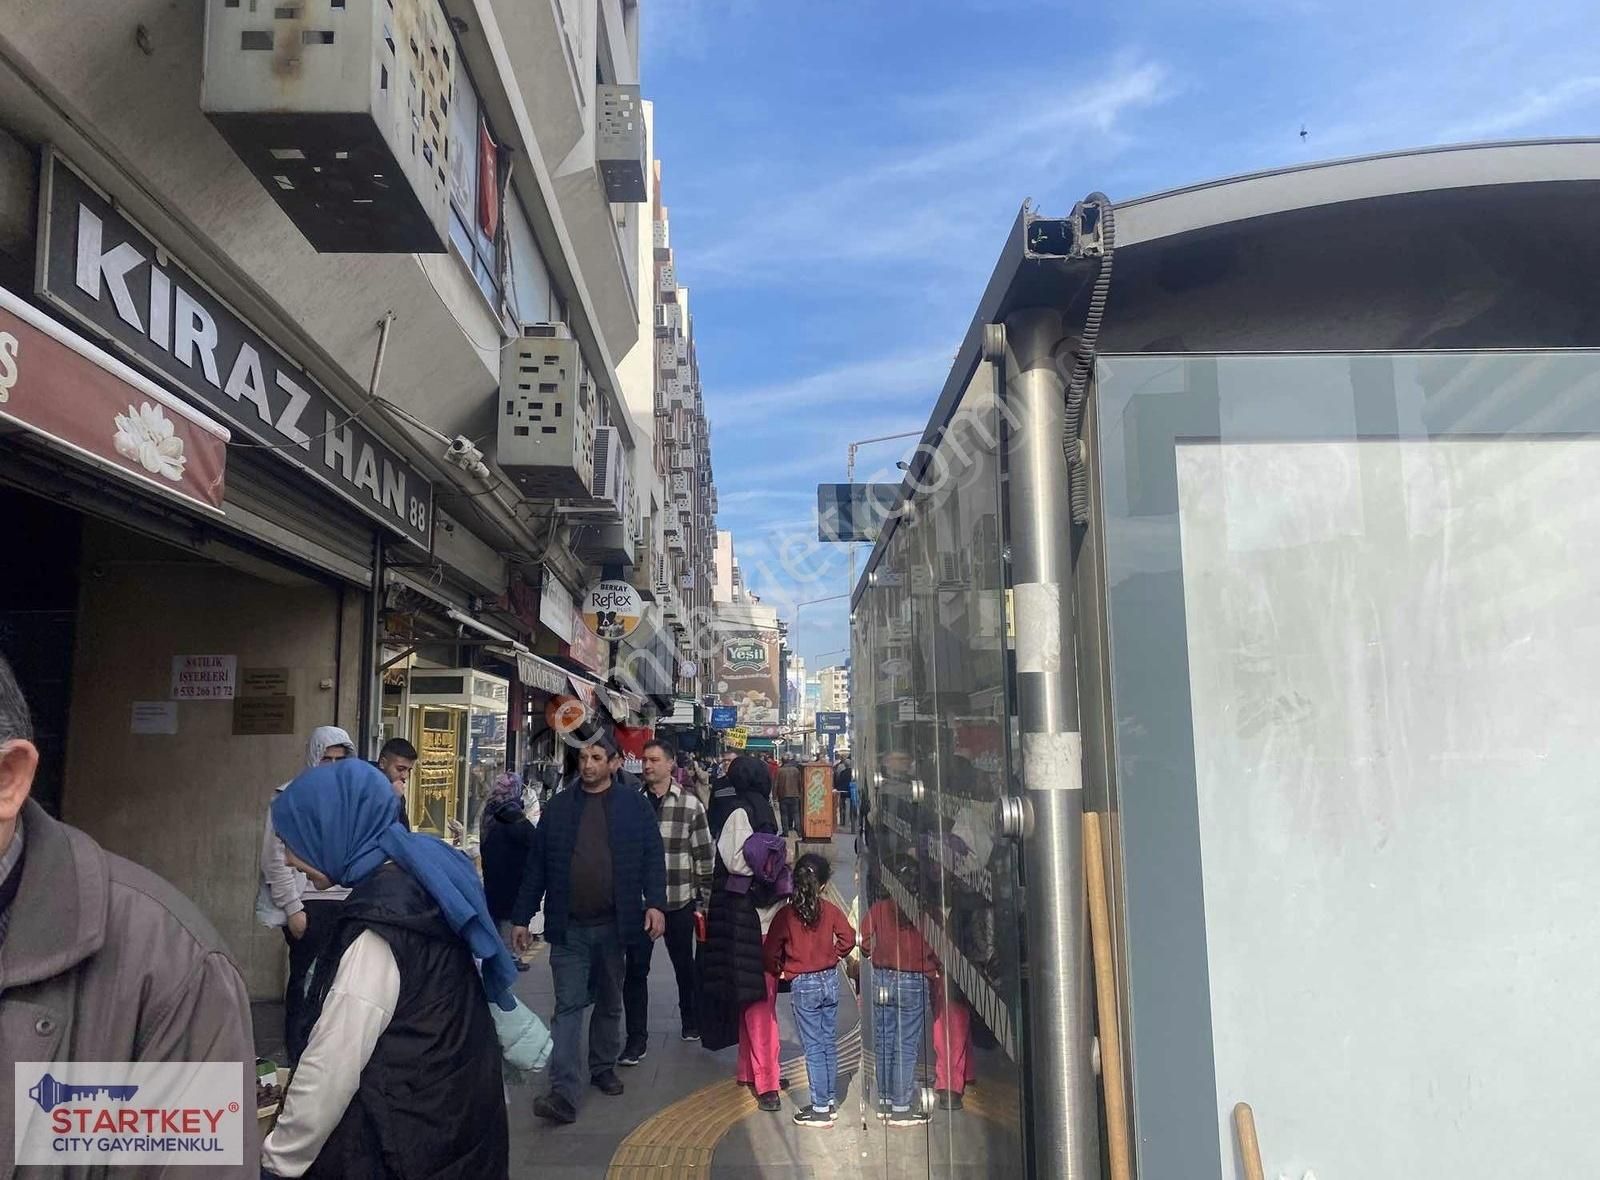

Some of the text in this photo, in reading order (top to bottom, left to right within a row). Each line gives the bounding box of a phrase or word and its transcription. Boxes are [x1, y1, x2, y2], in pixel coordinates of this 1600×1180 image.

[75, 202, 425, 532] KİRAZ HAN 88
[600, 583, 629, 592] BERKAY
[592, 592, 632, 609] Reflex
[186, 657, 223, 668] SATILIK
[213, 686, 222, 697] 17
[224, 686, 233, 696] 72
